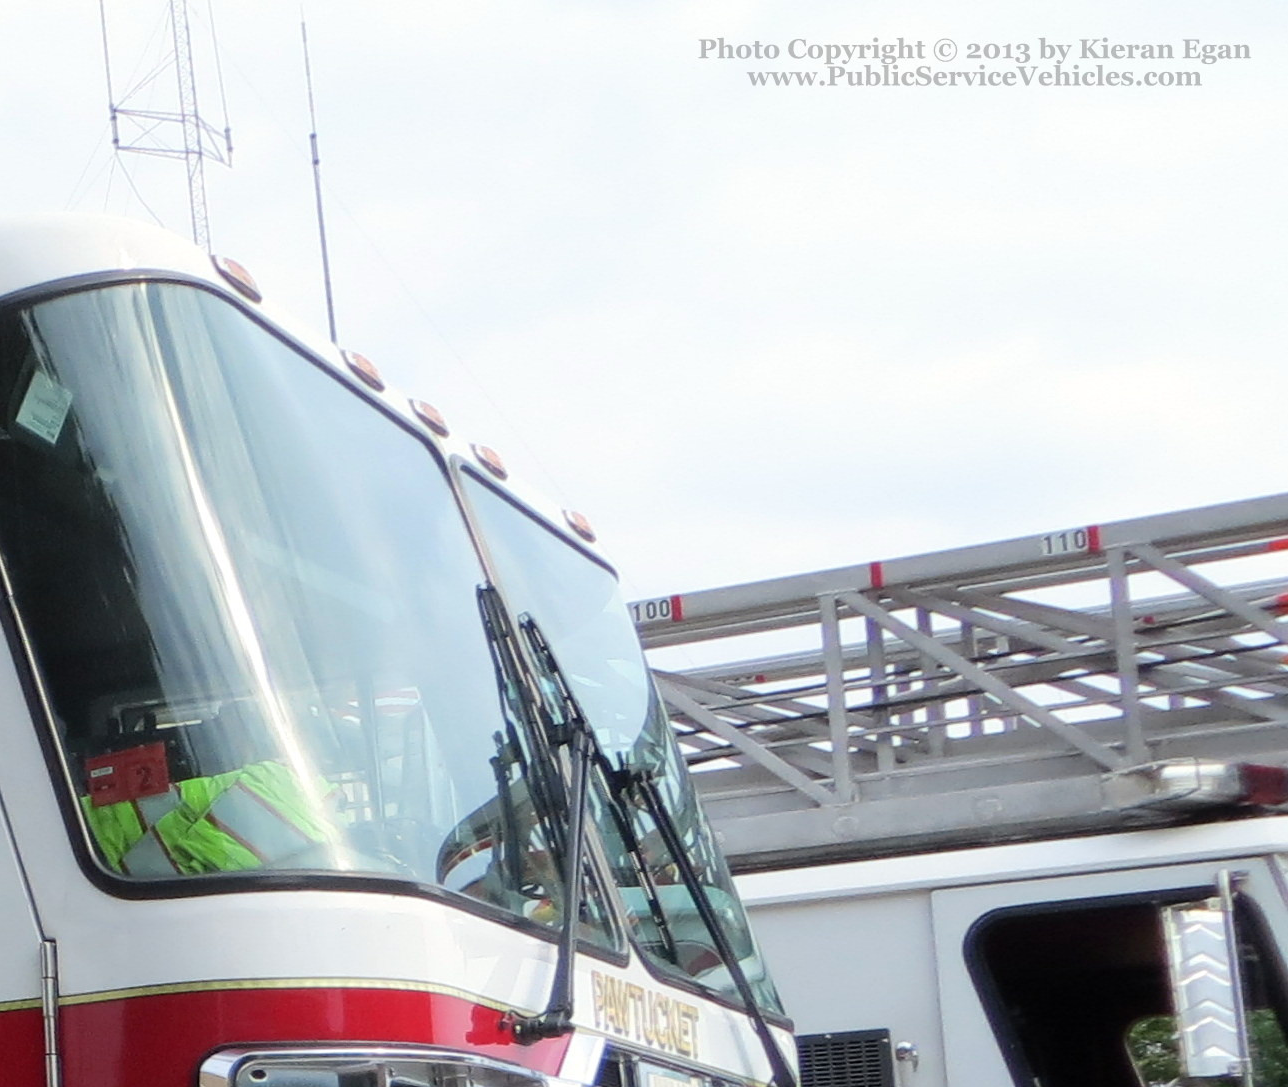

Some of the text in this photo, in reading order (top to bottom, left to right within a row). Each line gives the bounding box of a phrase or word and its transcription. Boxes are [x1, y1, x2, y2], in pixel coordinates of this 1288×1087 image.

[1043, 529, 1087, 554] 110
[632, 599, 670, 622] 100
[590, 969, 700, 1060] PAWTUCKET
